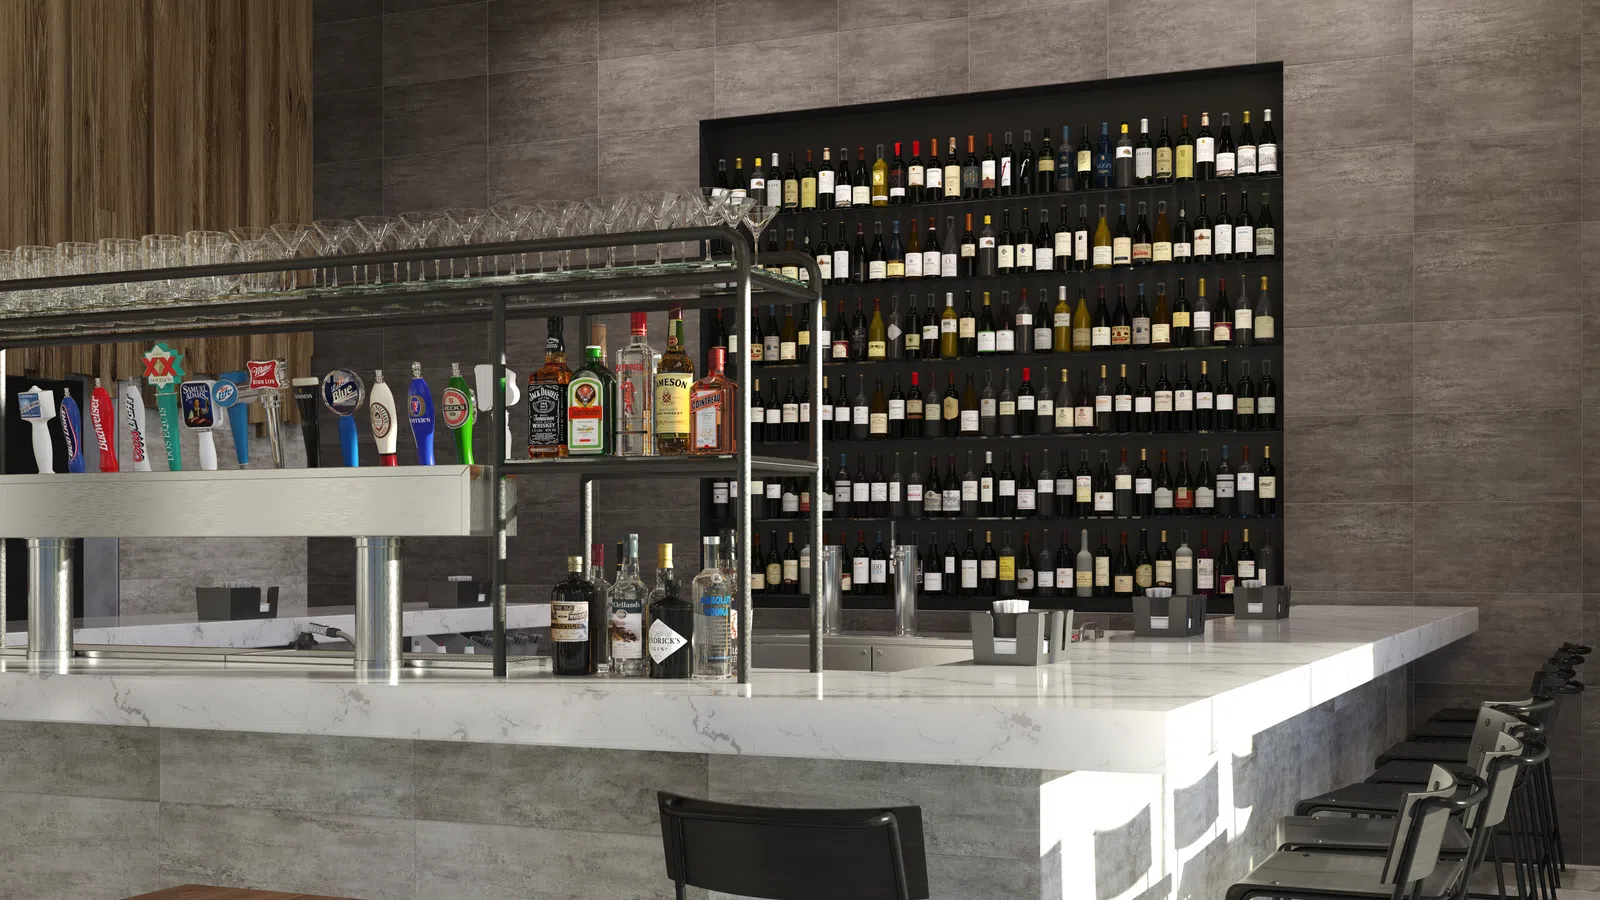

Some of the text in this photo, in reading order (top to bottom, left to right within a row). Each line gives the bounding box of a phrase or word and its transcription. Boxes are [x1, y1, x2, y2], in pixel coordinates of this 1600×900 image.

[182, 385, 209, 395] SAMUEL
[185, 391, 207, 402] ADAMS
[332, 384, 353, 403] Blue
[691, 393, 721, 410] COINTREAU
[90, 396, 108, 452] Budweiser
[159, 407, 175, 461] DOS EQUIS
[701, 595, 731, 605] ABSOLUT
[649, 637, 681, 645] NDRICK'S
